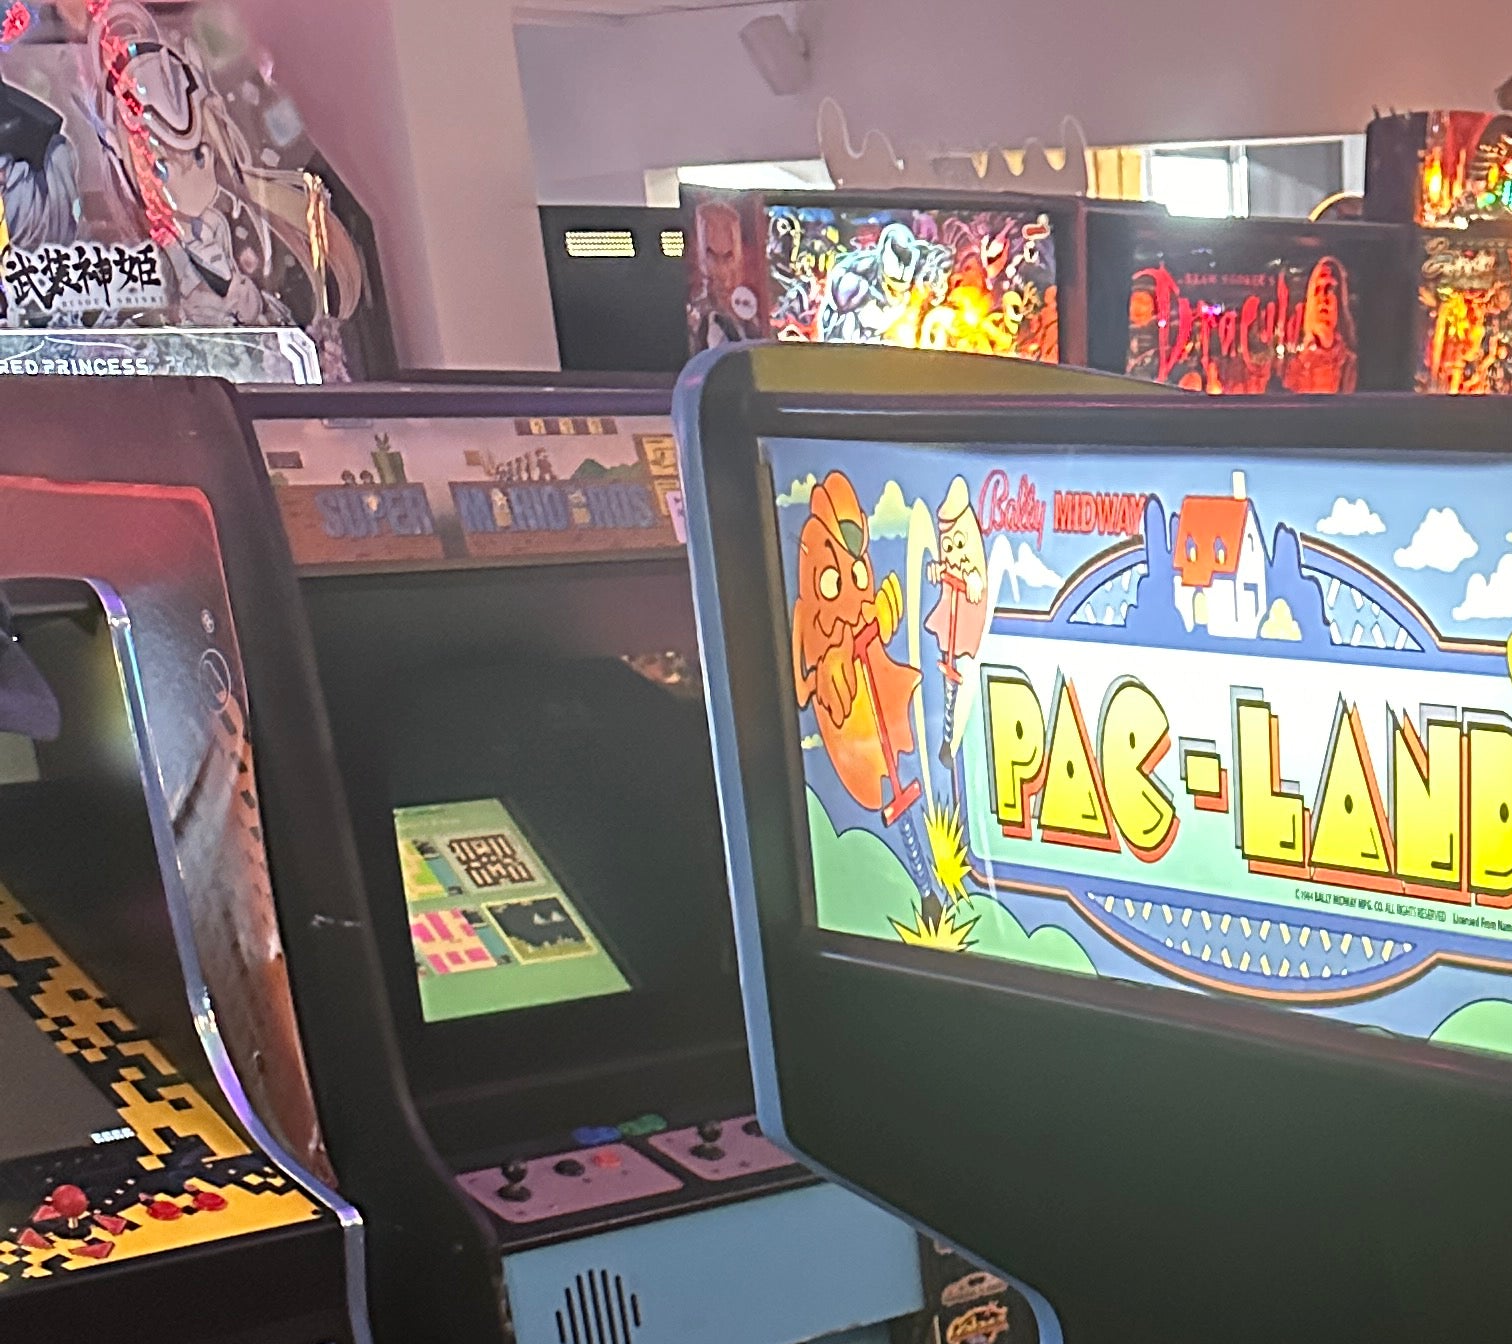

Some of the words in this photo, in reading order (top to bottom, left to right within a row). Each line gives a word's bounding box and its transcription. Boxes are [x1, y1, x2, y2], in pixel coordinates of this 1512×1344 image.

[5, 244, 162, 309] 武装神姫
[43, 357, 149, 376] PRINCESS
[453, 484, 568, 534] MRIO
[570, 484, 660, 530] ROS
[978, 469, 1046, 551] Bally
[1053, 489, 1147, 536] MIDWAY
